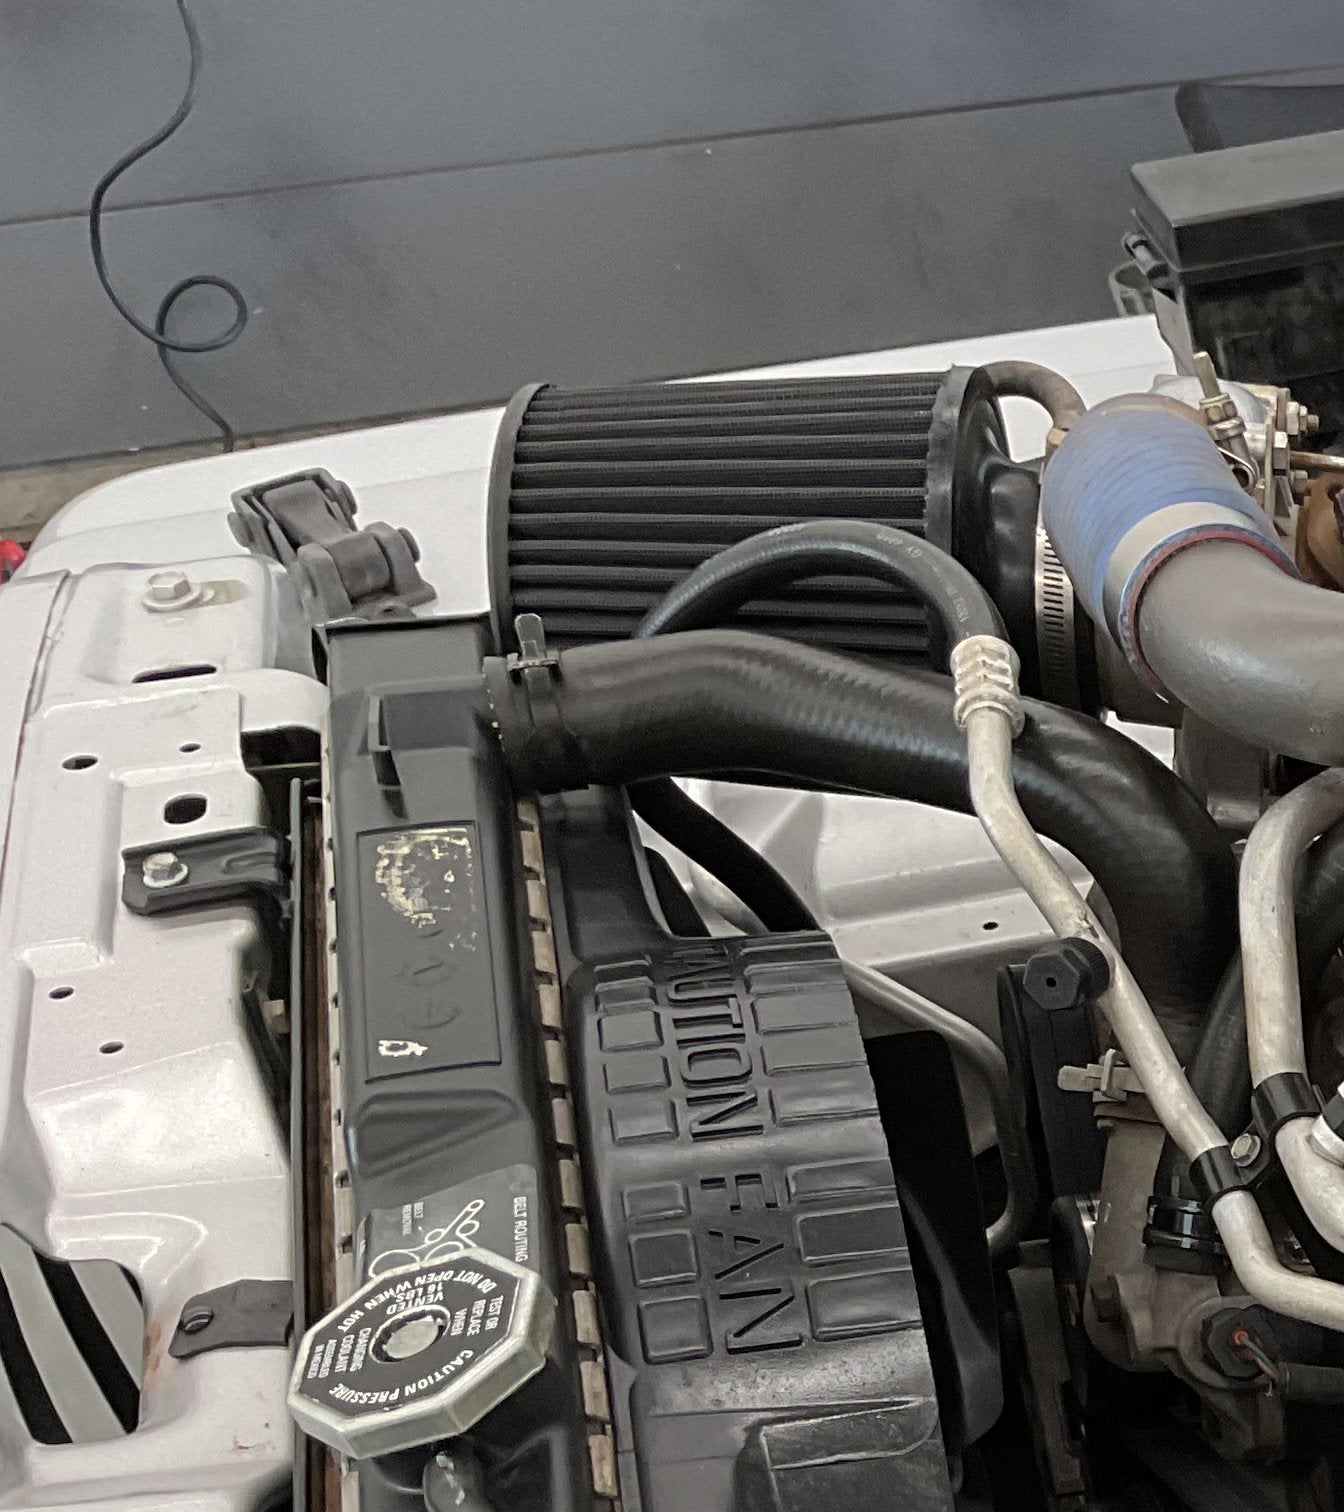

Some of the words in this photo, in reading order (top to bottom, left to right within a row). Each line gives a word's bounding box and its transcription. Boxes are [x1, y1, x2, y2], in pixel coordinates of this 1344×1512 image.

[513, 1196, 527, 1218] BELT
[514, 1219, 528, 1262] ROUTING
[700, 1173, 803, 1354] FAN
[415, 1270, 454, 1286] OPEN
[453, 1270, 481, 1286] NOT
[478, 1279, 496, 1294] DO
[364, 1282, 411, 1310] WHEN
[386, 1291, 444, 1315] VENTED
[488, 1295, 503, 1316] TEST
[337, 1310, 364, 1333] HOT
[451, 1308, 468, 1335] WHEN
[467, 1299, 486, 1336] REPLACE
[485, 1317, 499, 1331] OR
[335, 1334, 354, 1372] COOLANT
[350, 1327, 371, 1372] CHANGING
[404, 1350, 474, 1396] CAUTION
[328, 1383, 400, 1404] PRESSURE
